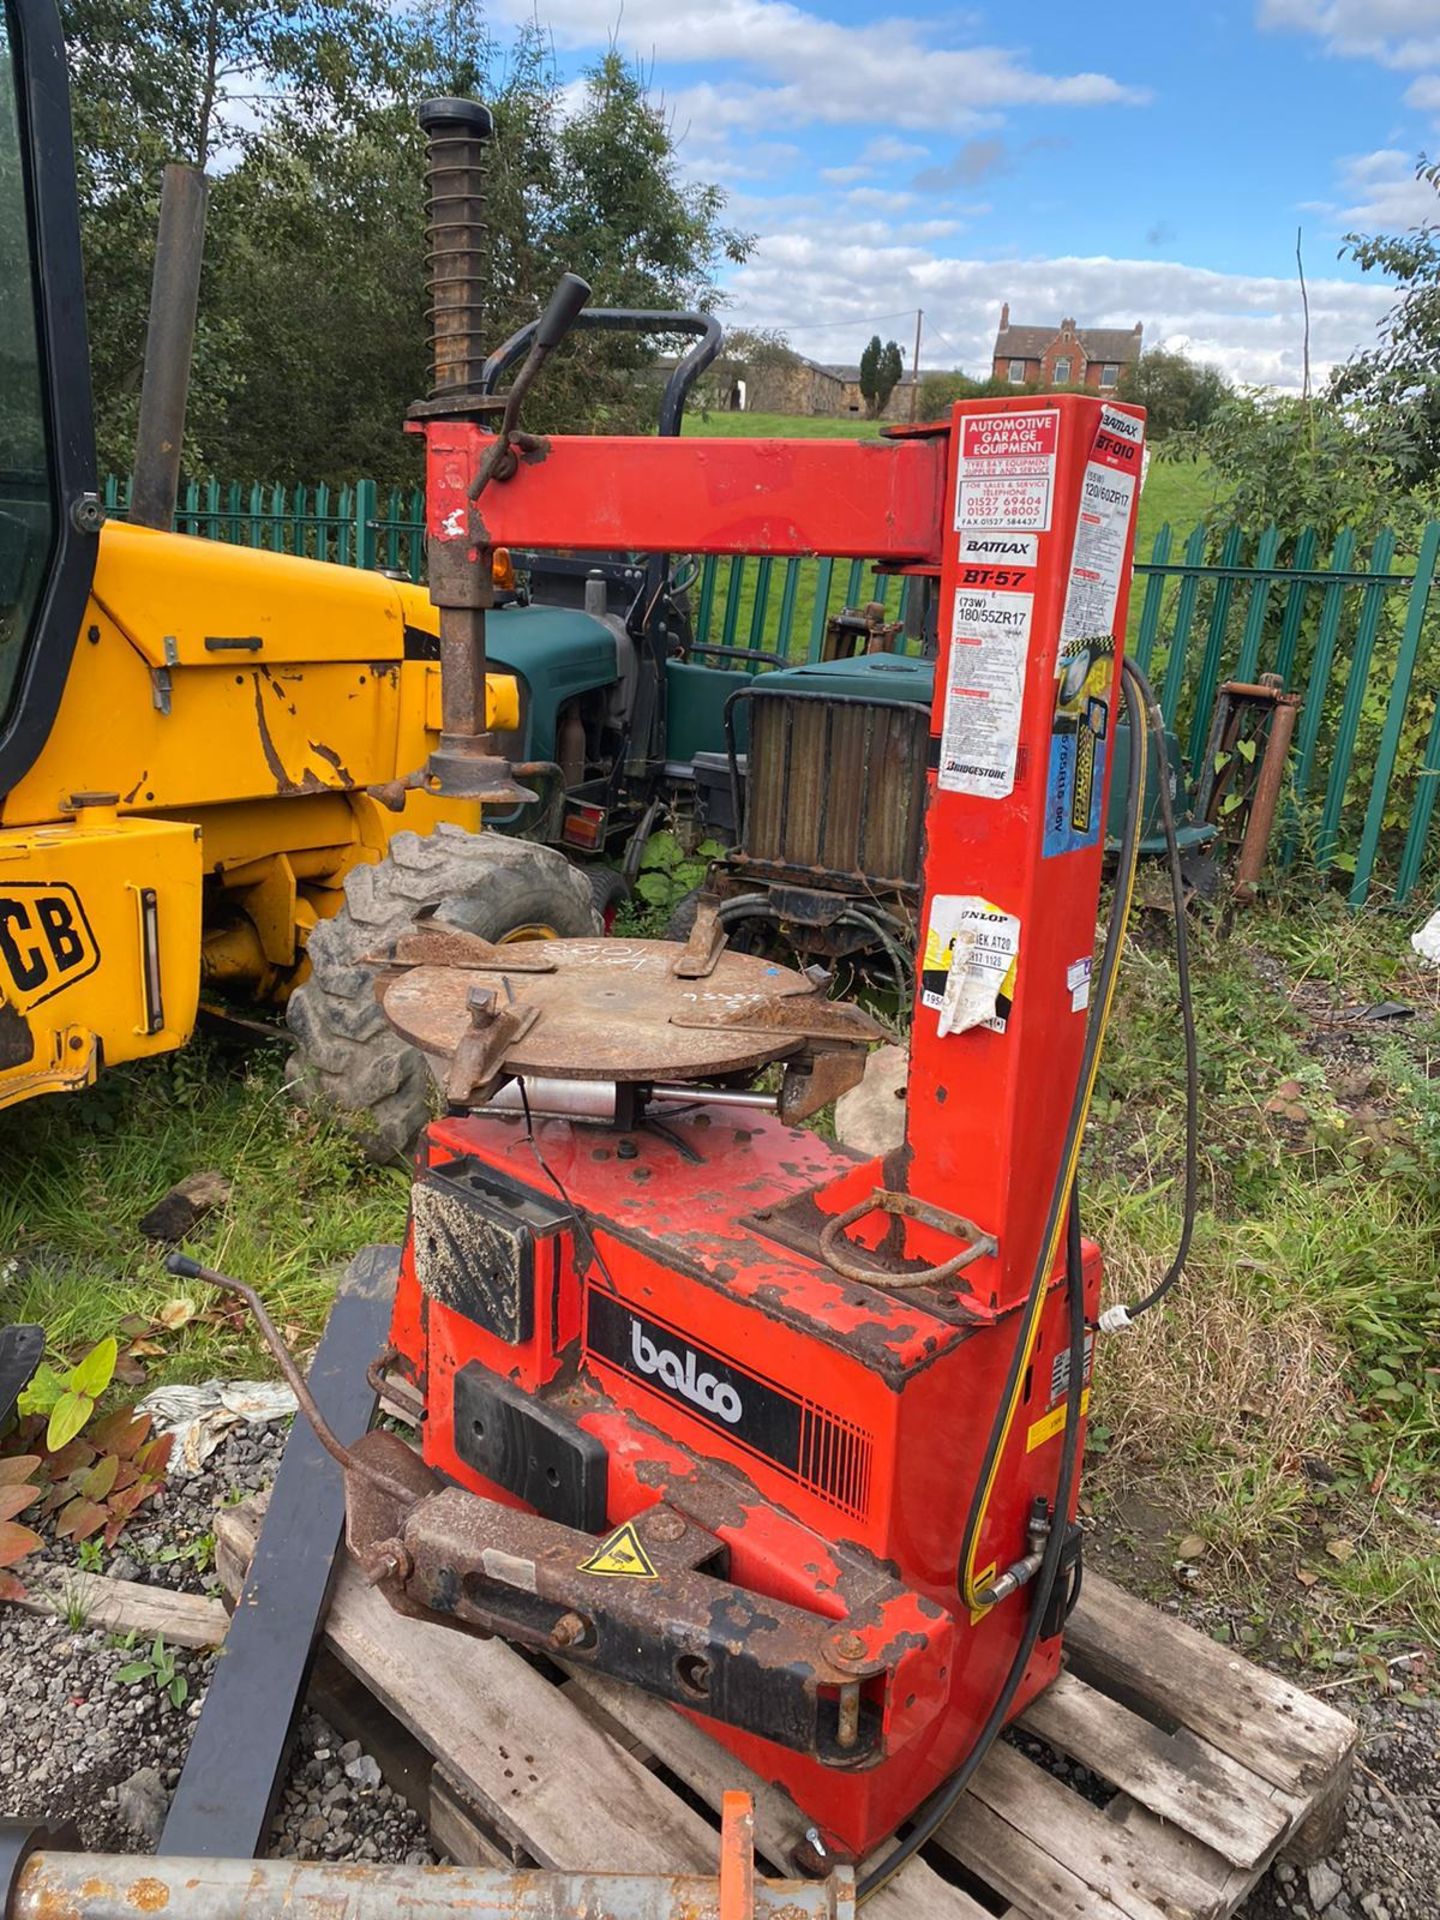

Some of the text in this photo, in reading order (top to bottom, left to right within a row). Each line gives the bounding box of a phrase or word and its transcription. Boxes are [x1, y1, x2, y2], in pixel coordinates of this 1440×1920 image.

[969, 416, 1052, 433] AUTOMOTIVE
[981, 430, 1038, 443] GARAGE
[973, 441, 1043, 455] EQUIPMENT
[1096, 435, 1135, 460] BT-010
[966, 459, 1049, 469] TYRE BAY EQUIPMENT
[1000, 467, 1017, 475] AND
[1021, 466, 1049, 474] SERVICE
[983, 488, 1027, 497] TELEPHONE
[1085, 483, 1129, 506] 120/60ZR17
[967, 496, 1041, 506] 01527 69404
[967, 506, 1040, 516] 01527 68005
[962, 569, 1026, 586] BT-57
[959, 598, 986, 608] (73W)
[959, 608, 1027, 626] 180/55ZR17
[945, 760, 1007, 780] BRIDGESTONE
[991, 936, 1011, 951] AT20
[631, 1319, 743, 1423] balco
